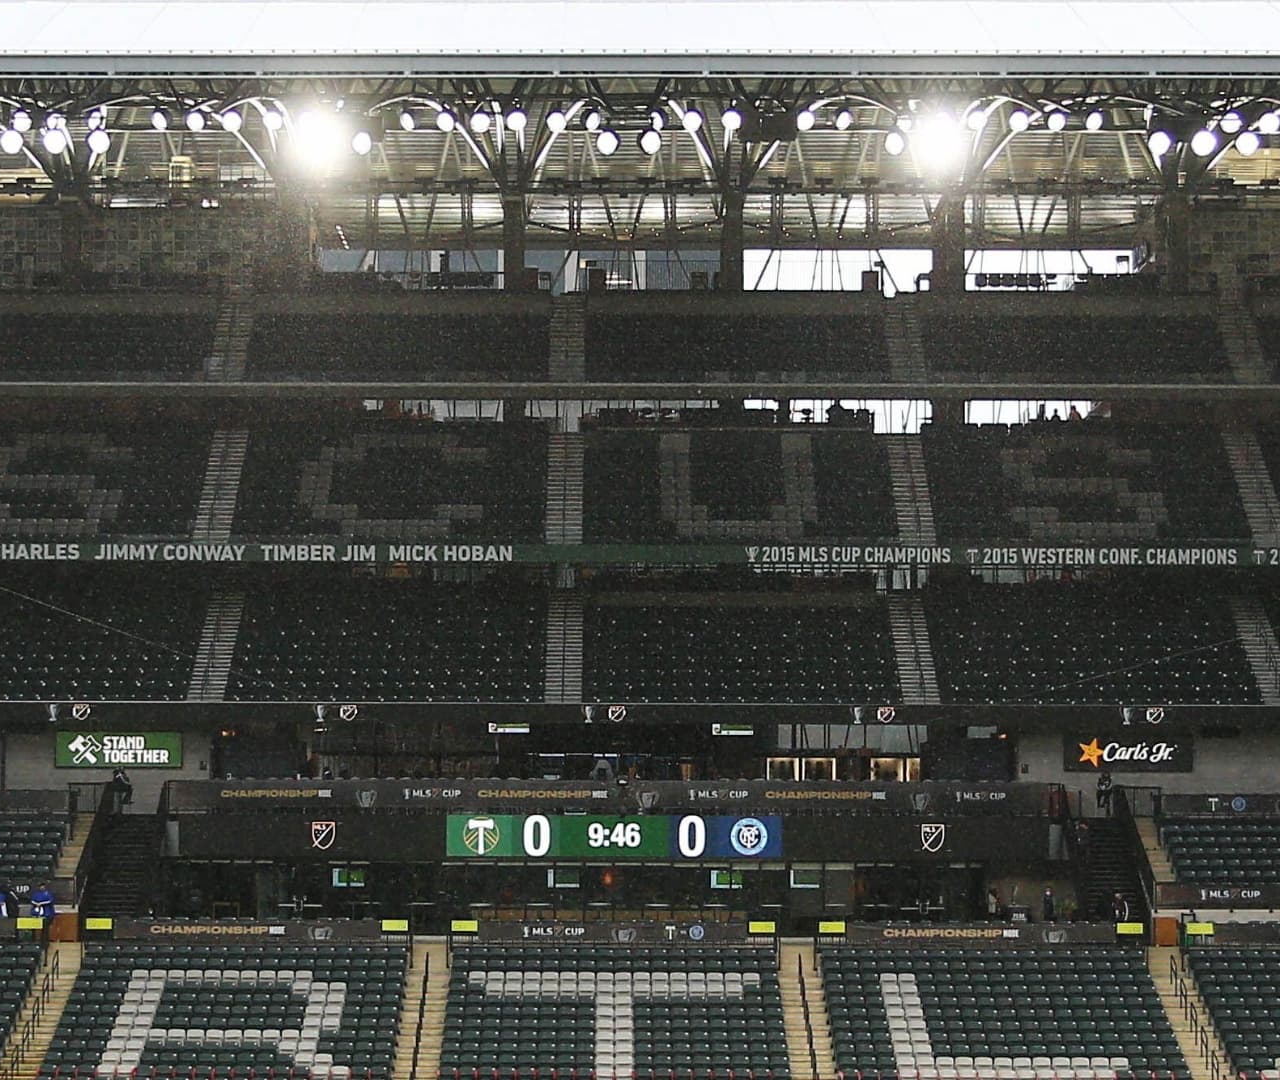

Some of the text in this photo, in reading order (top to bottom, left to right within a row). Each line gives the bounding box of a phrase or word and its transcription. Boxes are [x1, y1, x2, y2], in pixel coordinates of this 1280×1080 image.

[95, 544, 245, 561] JIMMY CONWAY
[261, 545, 375, 561] TIMBER JIM
[389, 545, 513, 562] MICK HOBAN
[762, 547, 951, 563] 2015 MLS CUP CHAMPIONS
[983, 548, 1236, 565] 2015 WESTERN CONF. CHAMPIONS
[103, 735, 144, 750] STAND
[103, 749, 168, 763] TOGETHER
[1102, 742, 1173, 763] Carl's Jr.
[221, 789, 318, 798] CHAMPIONSHIP
[412, 789, 461, 798] MLS CUP
[477, 790, 592, 798] CHAMPIONSHIP
[698, 791, 748, 799] MLS CUP
[765, 791, 871, 799] CHAMPIONSHIP
[523, 814, 550, 857] 0
[588, 823, 641, 848] 9:46
[678, 815, 705, 857] 0
[1210, 890, 1261, 898] MLS CUP
[150, 926, 269, 935] CHAMPIONSHIP
[532, 927, 585, 937] MLS CUP
[883, 928, 1002, 937] CHAMPIONSHIP
